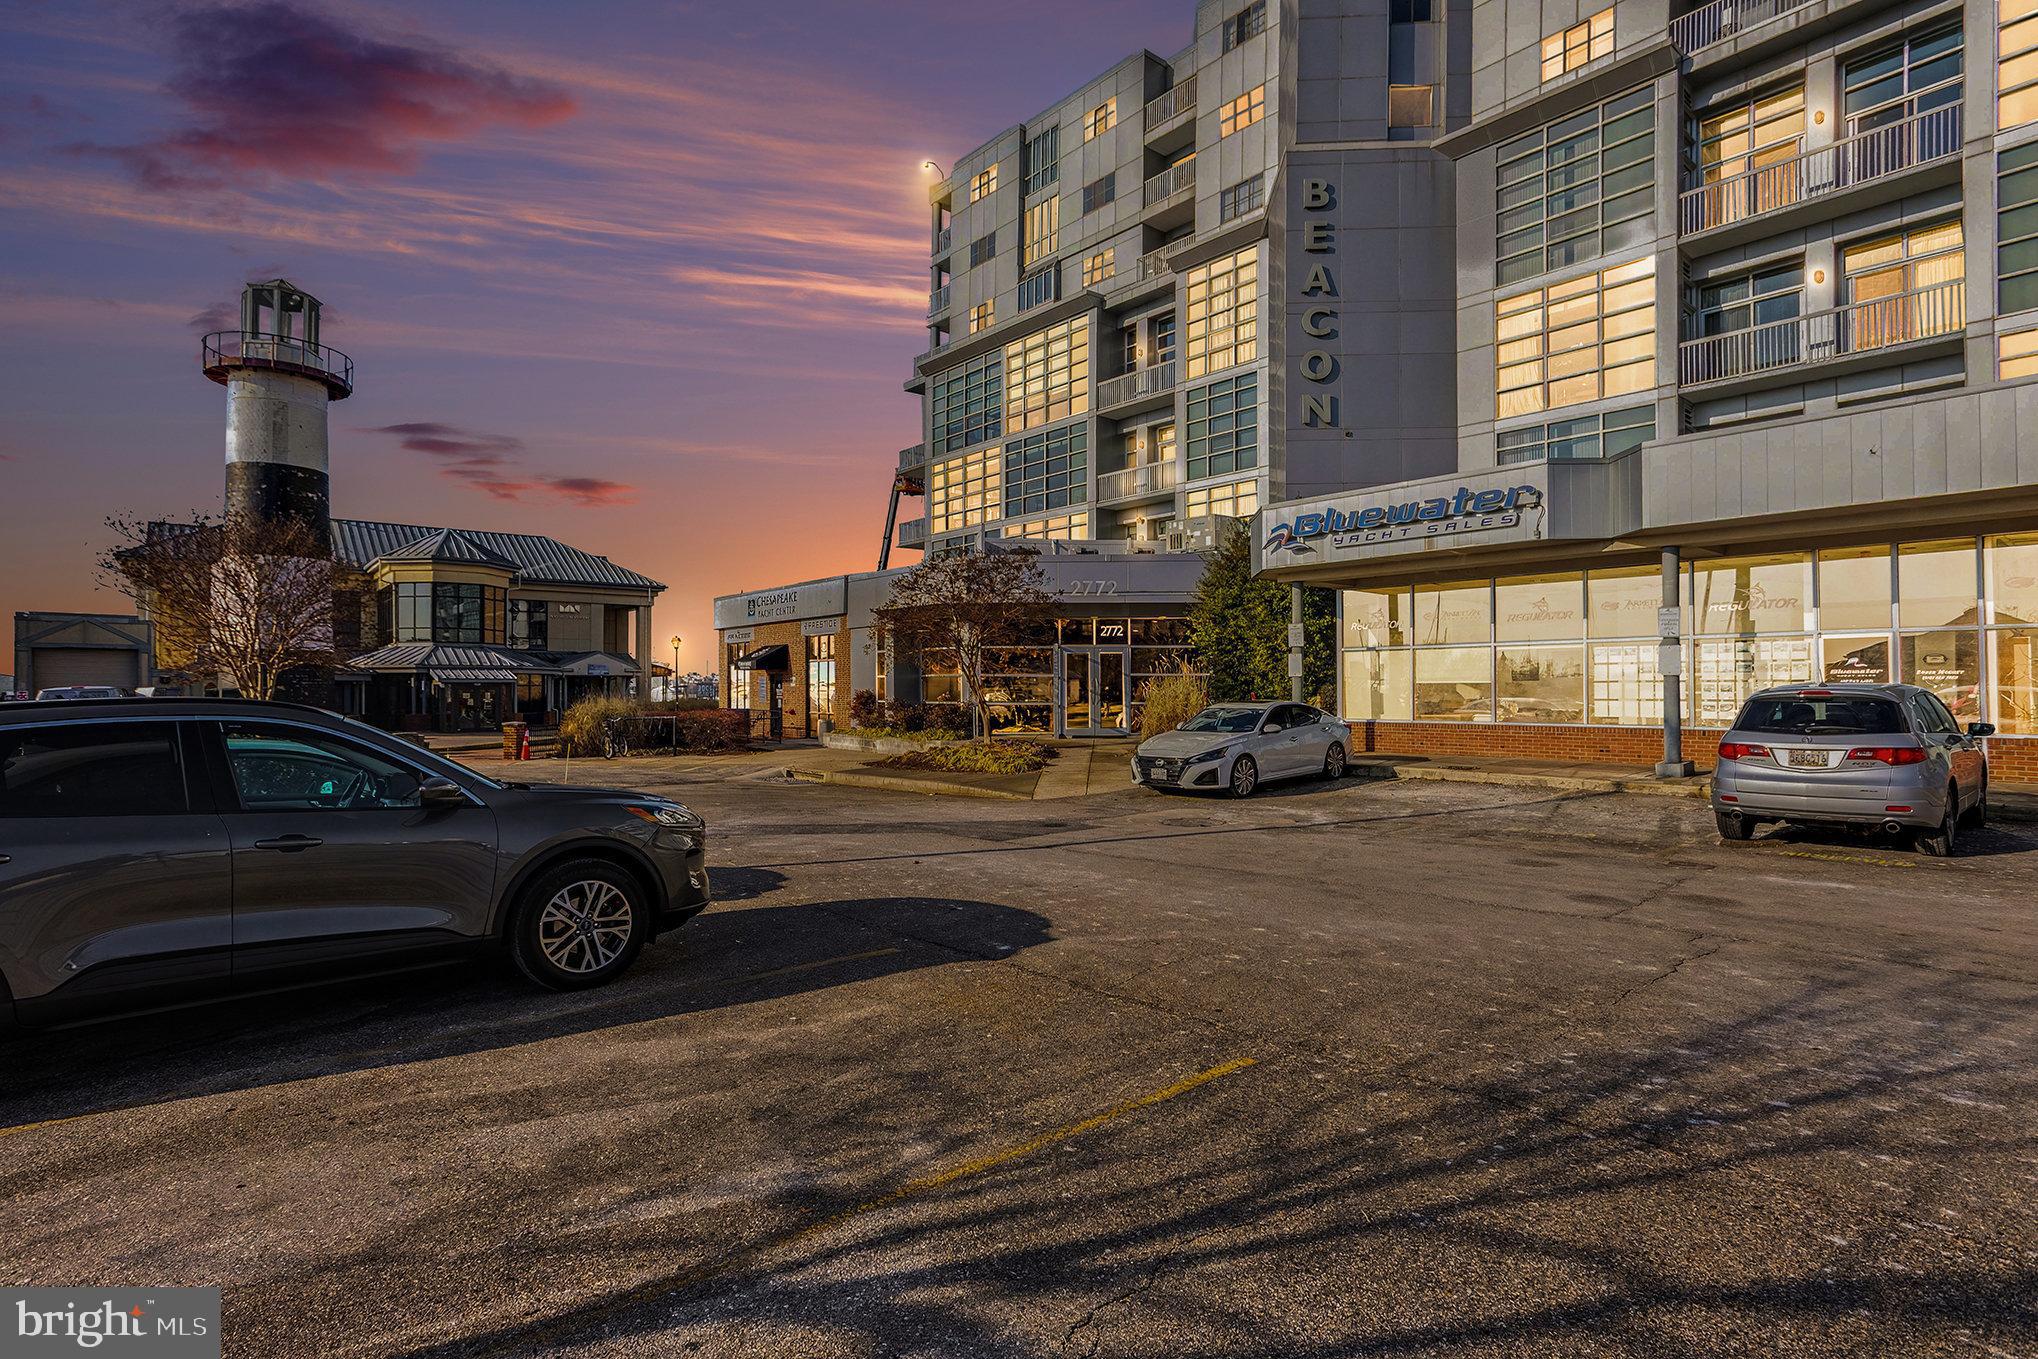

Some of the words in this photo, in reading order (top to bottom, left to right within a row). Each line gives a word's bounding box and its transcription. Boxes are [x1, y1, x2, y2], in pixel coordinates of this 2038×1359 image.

[1300, 178, 1335, 425] BEACON
[1292, 484, 1541, 538] Bluewater
[1332, 527, 1412, 546] YACHT
[1426, 513, 1516, 533] SALES
[1070, 580, 1118, 597] 2772
[756, 591, 798, 607] CHESAPEAKE
[1708, 597, 1800, 612] REGULATOR
[1100, 625, 1124, 637] 2772
